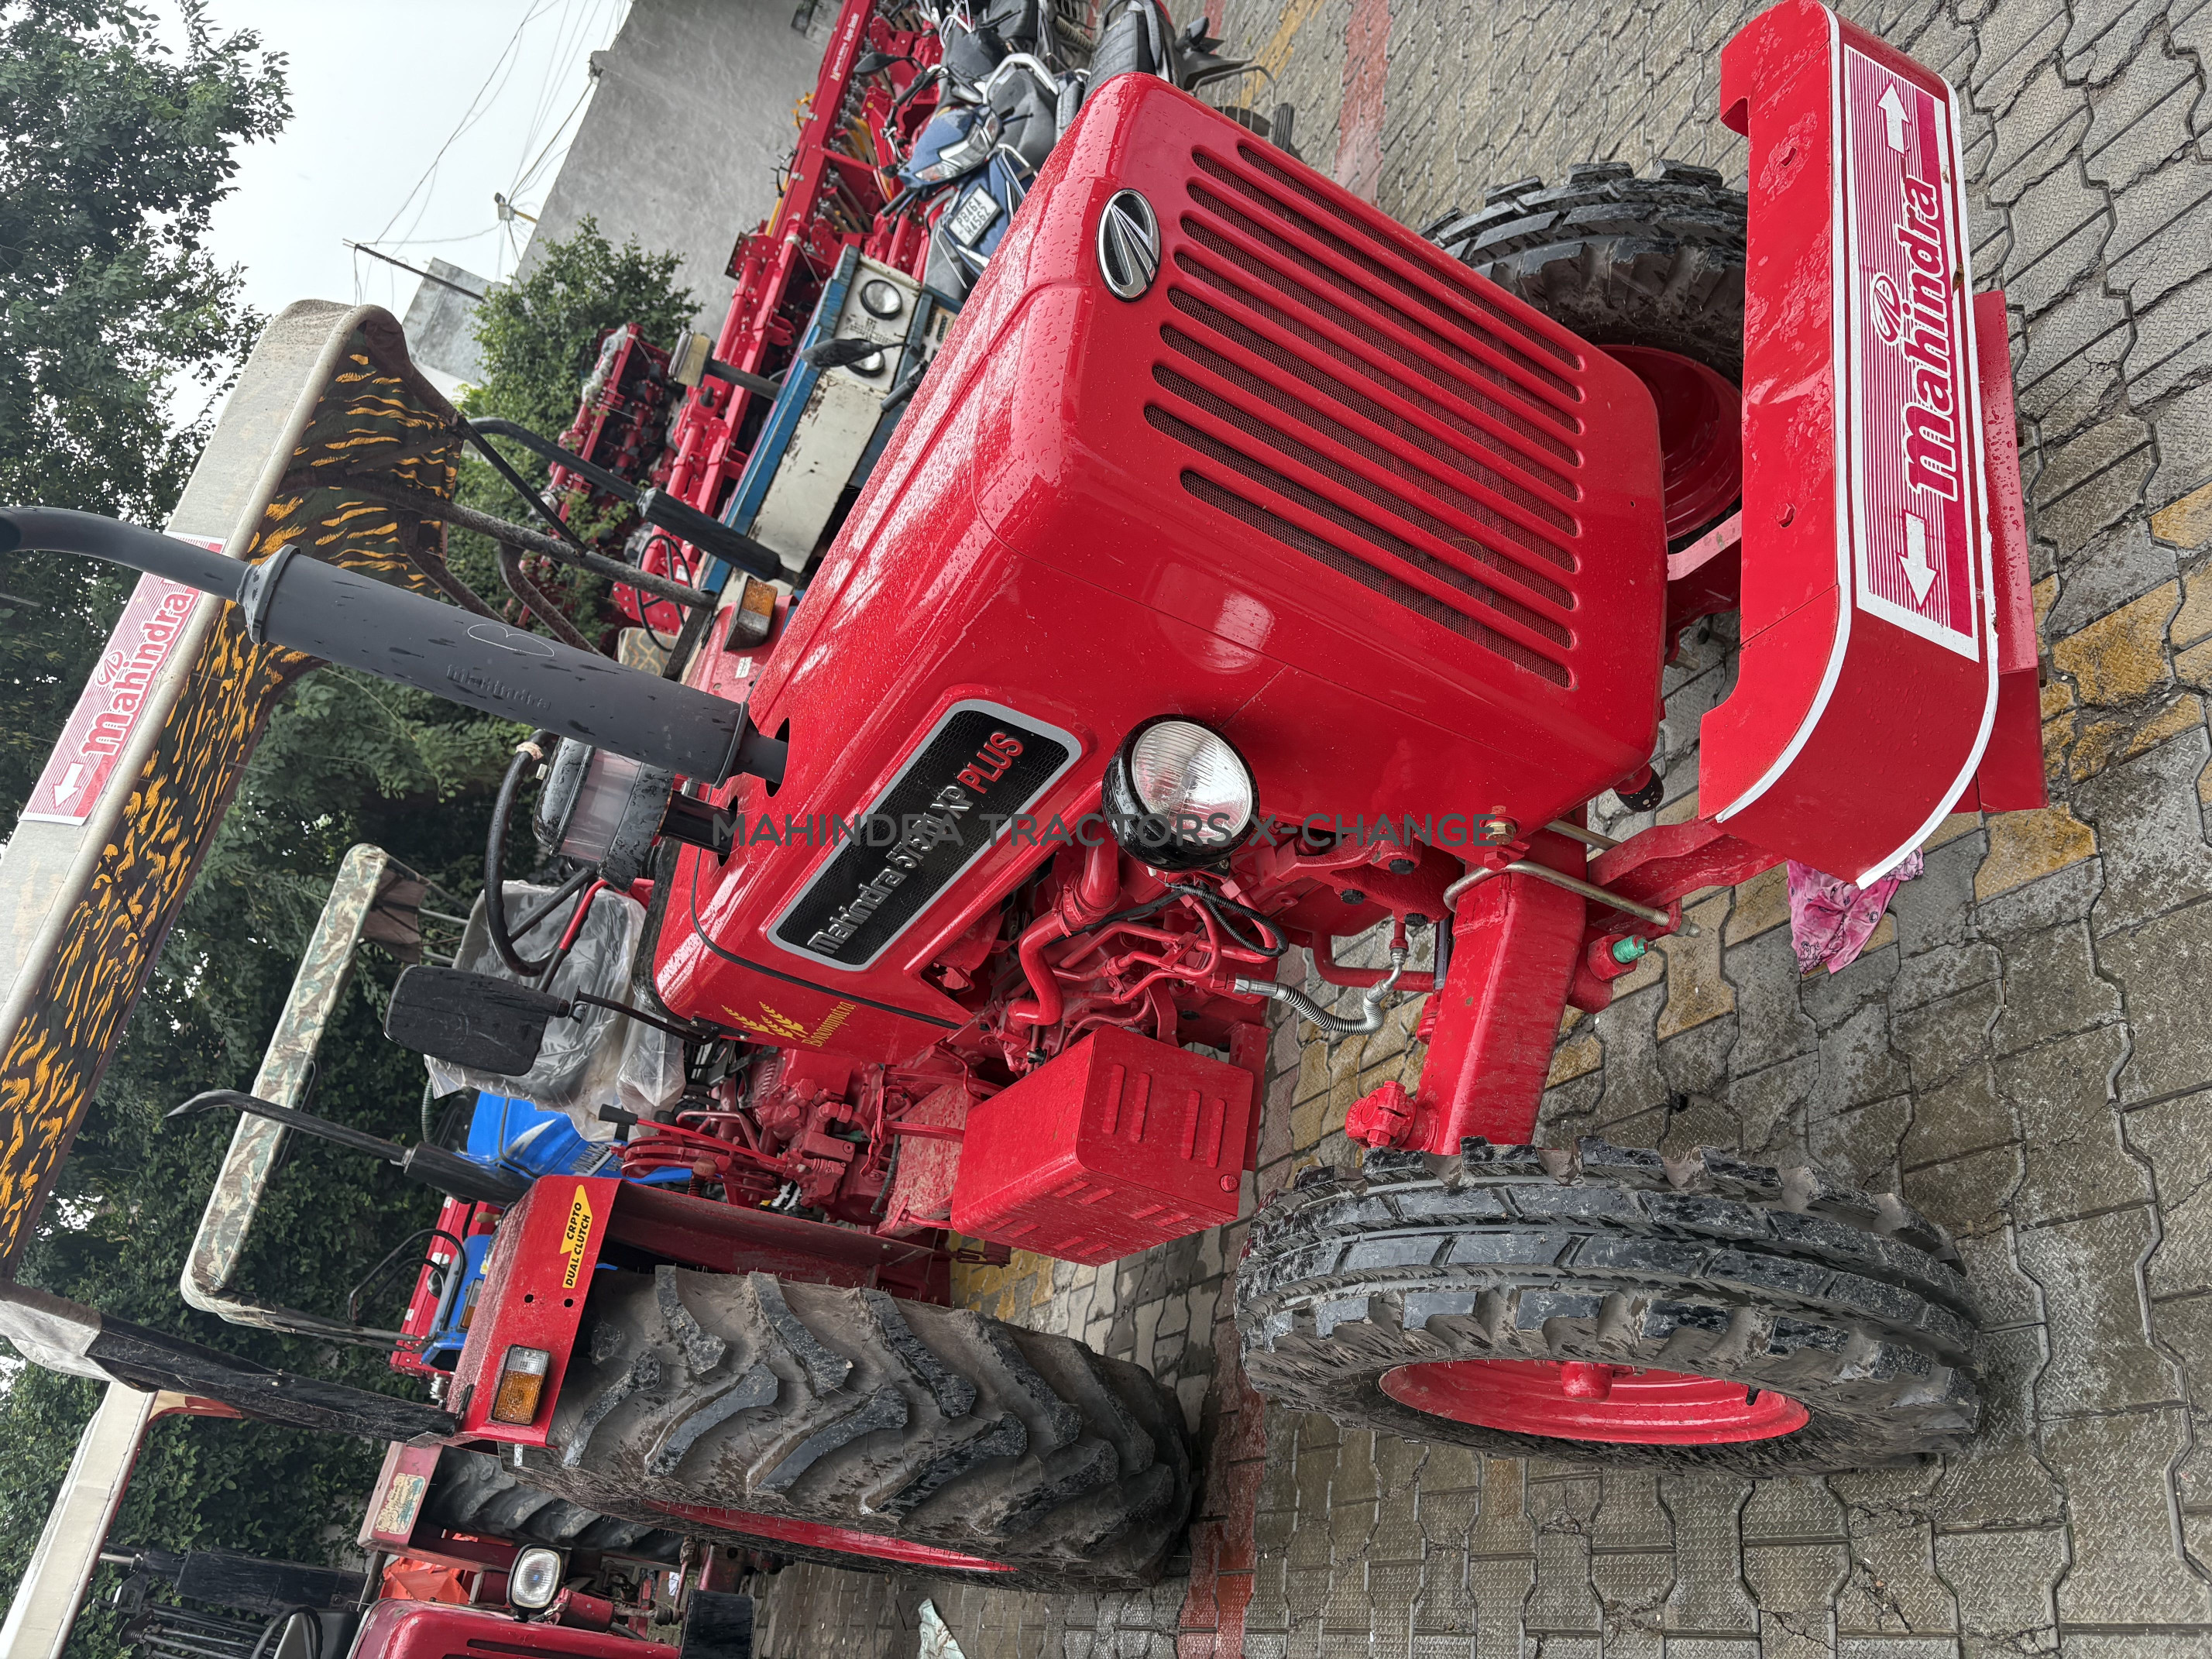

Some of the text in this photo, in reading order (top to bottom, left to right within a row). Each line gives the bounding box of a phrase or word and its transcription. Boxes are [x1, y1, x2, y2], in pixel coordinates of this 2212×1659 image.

[964, 205, 991, 236] H4562
[929, 785, 974, 820] XP
[957, 731, 1024, 795] PLUS
[566, 1202, 582, 1240] CRPTO
[565, 1214, 590, 1286] DUAL CLUTCH
